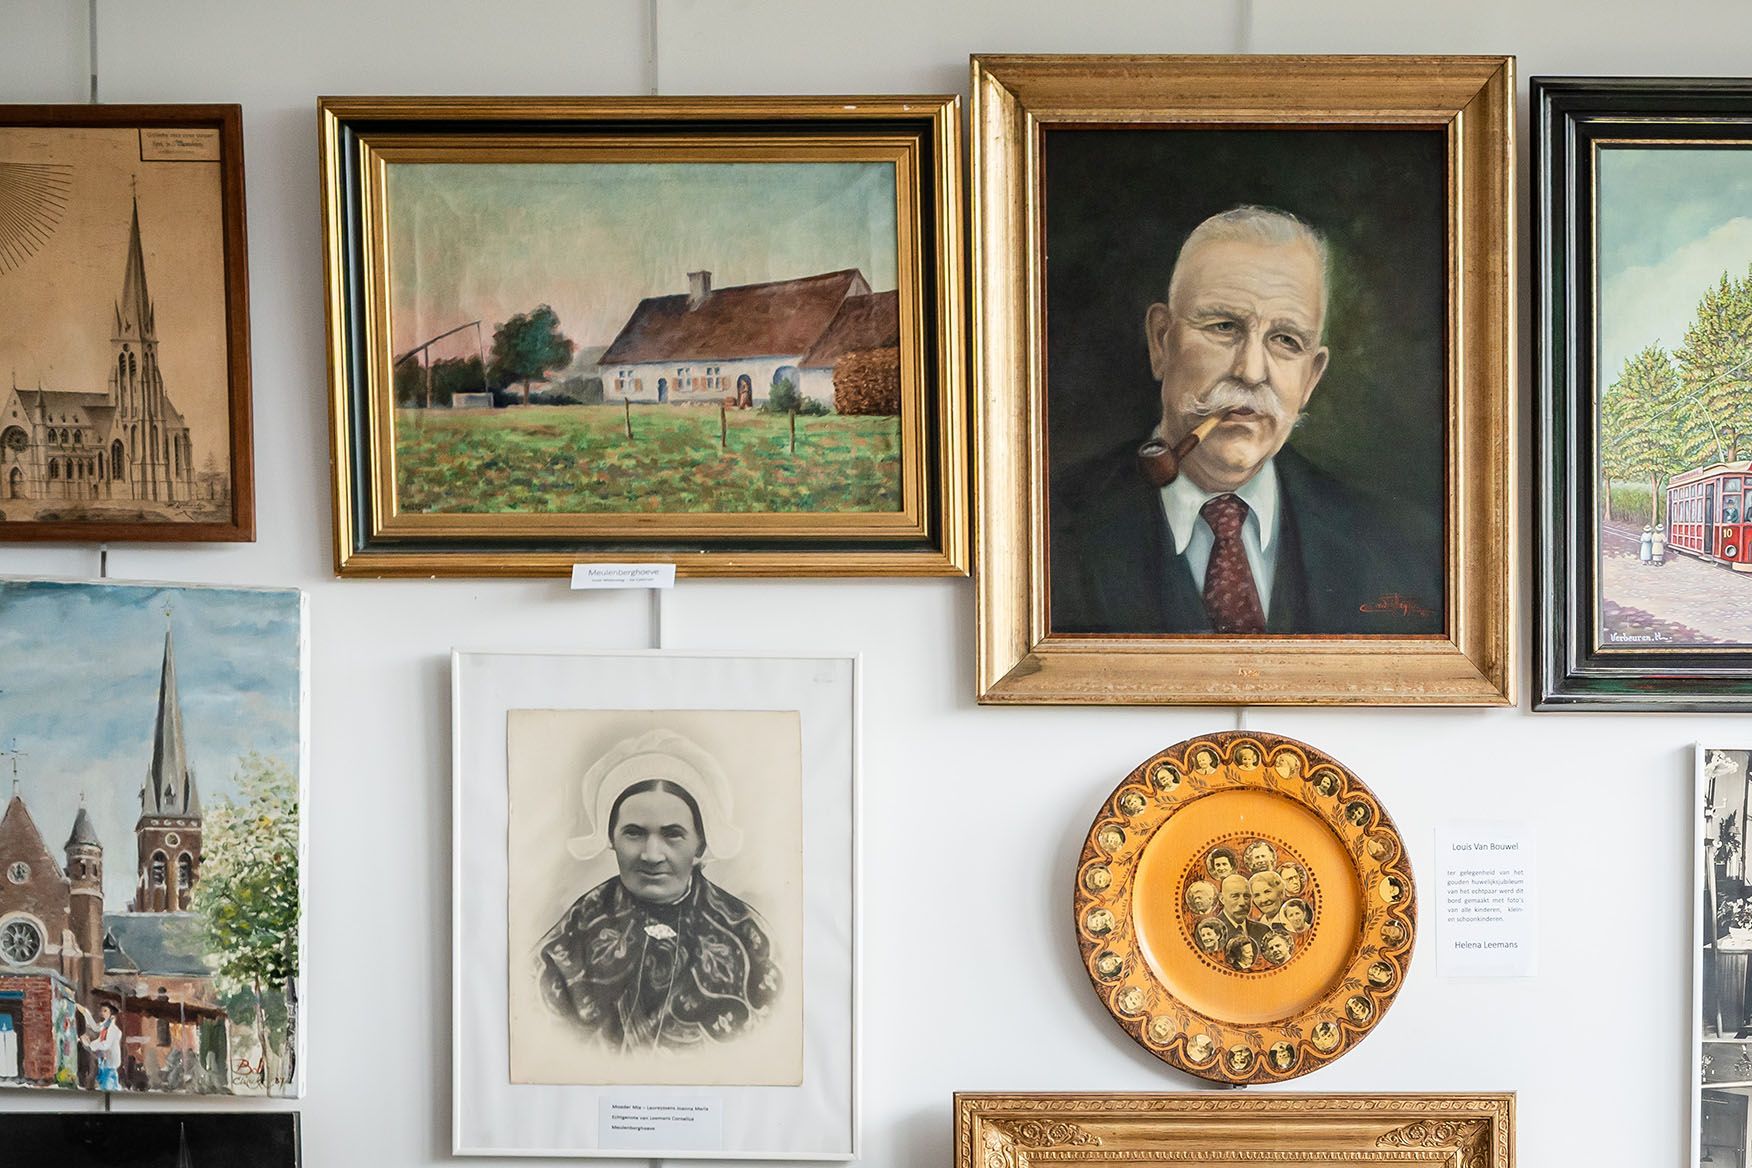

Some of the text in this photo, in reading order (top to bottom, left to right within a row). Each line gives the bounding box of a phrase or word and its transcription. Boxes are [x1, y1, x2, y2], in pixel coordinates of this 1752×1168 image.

[1723, 529, 1733, 538] 10
[1452, 843, 1519, 851] Louis Van Bouwel
[1471, 888, 1497, 896] echtpaar
[1454, 941, 1518, 949] Helena Leemans
